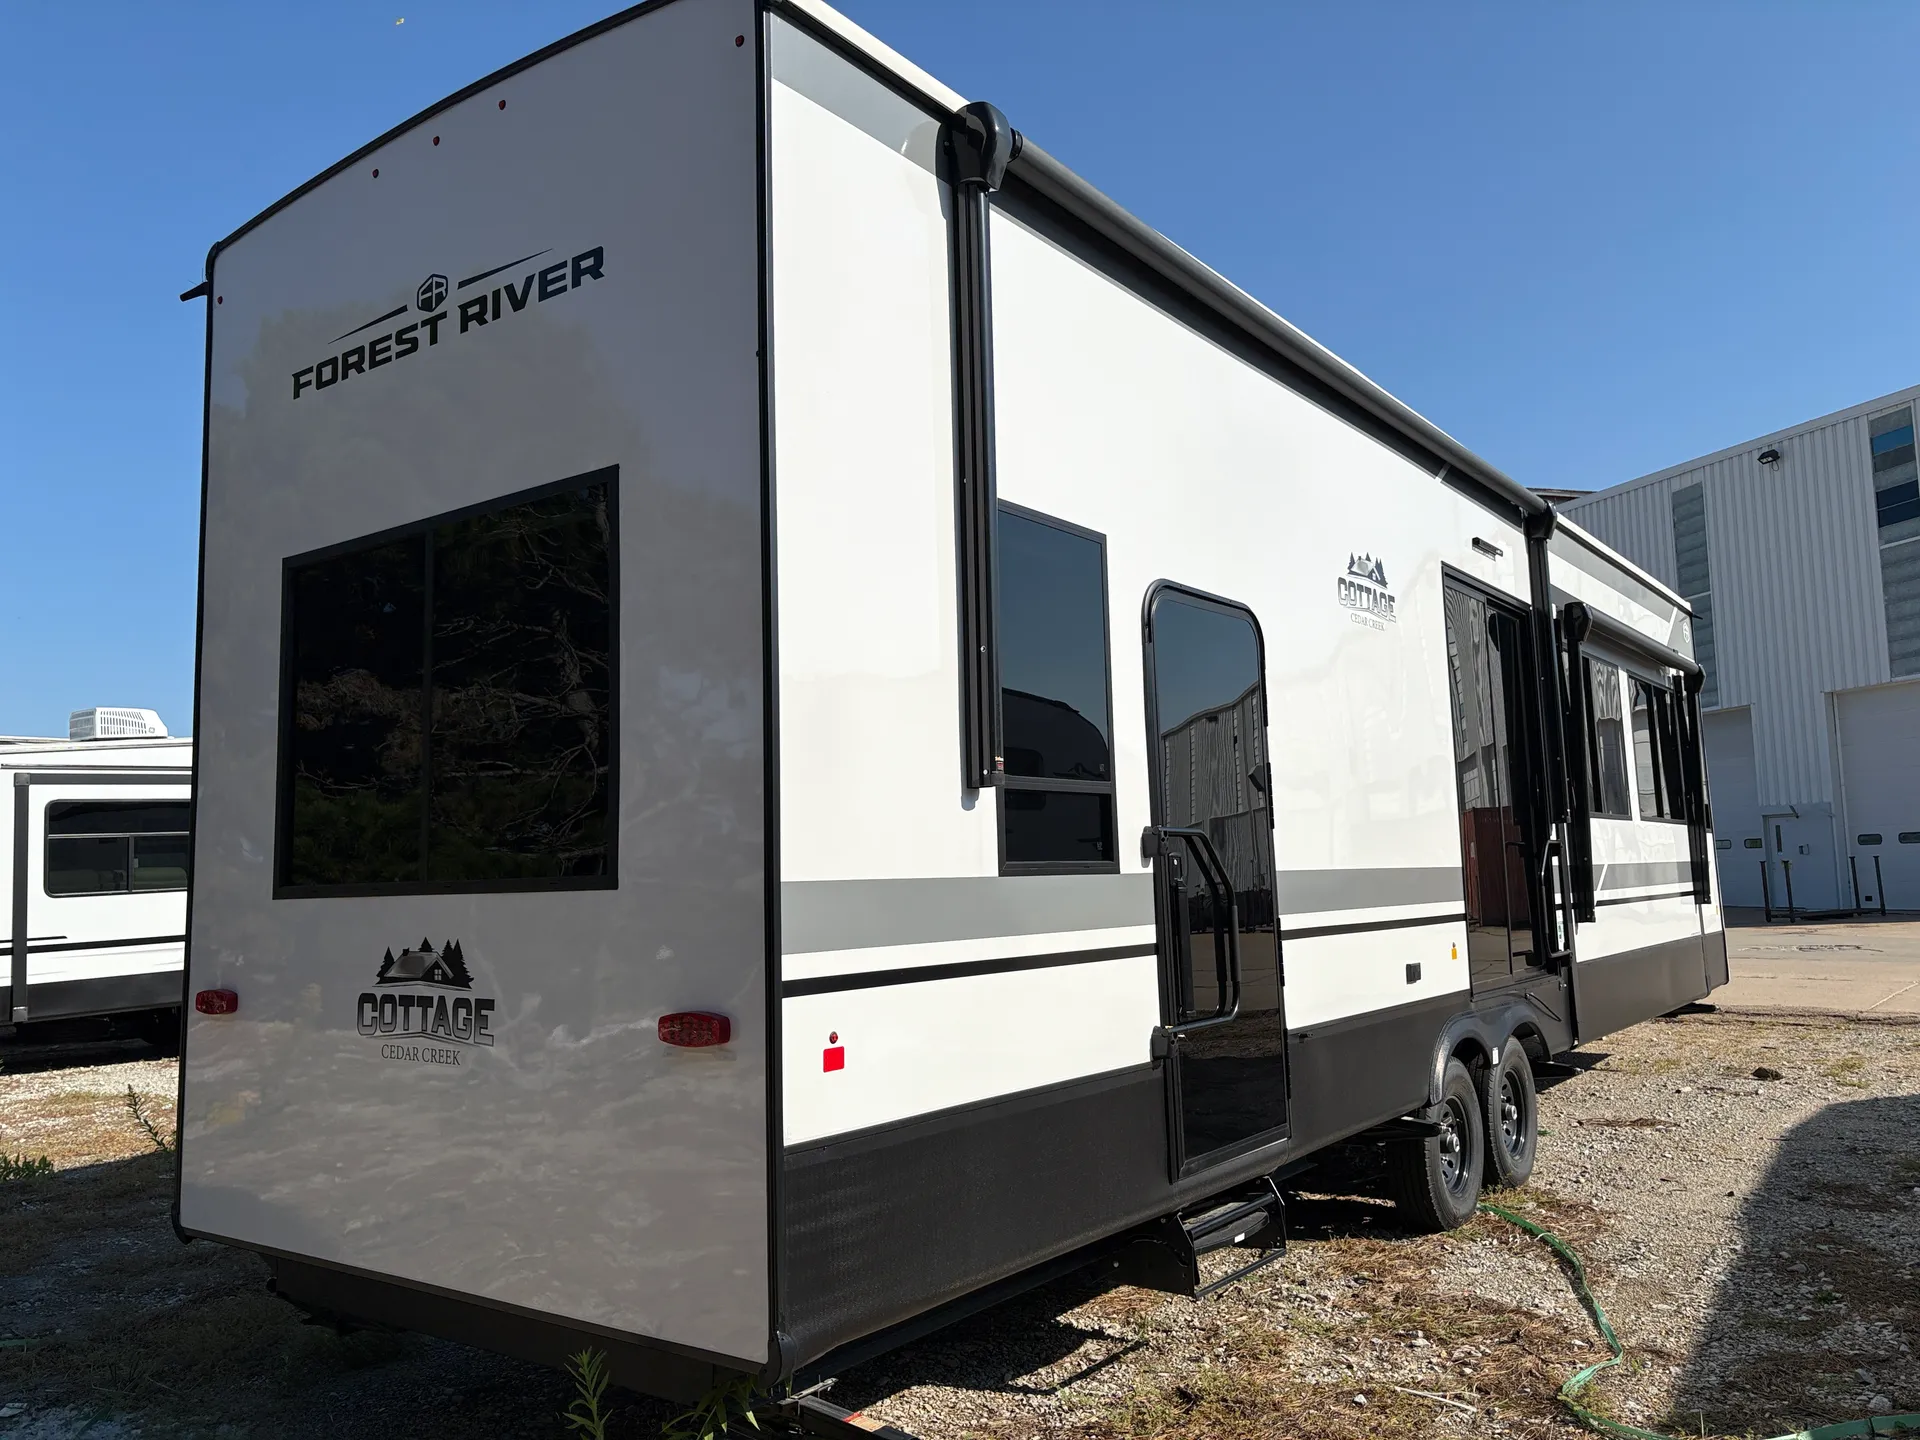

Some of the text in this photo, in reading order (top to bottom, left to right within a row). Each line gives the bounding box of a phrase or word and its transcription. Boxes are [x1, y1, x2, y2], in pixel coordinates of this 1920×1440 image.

[291, 245, 605, 401] FOREST RIVER
[1337, 576, 1397, 623] COTTAGE
[356, 992, 496, 1047] COTTAGE
[381, 1043, 461, 1066] CEDAR CREEK
